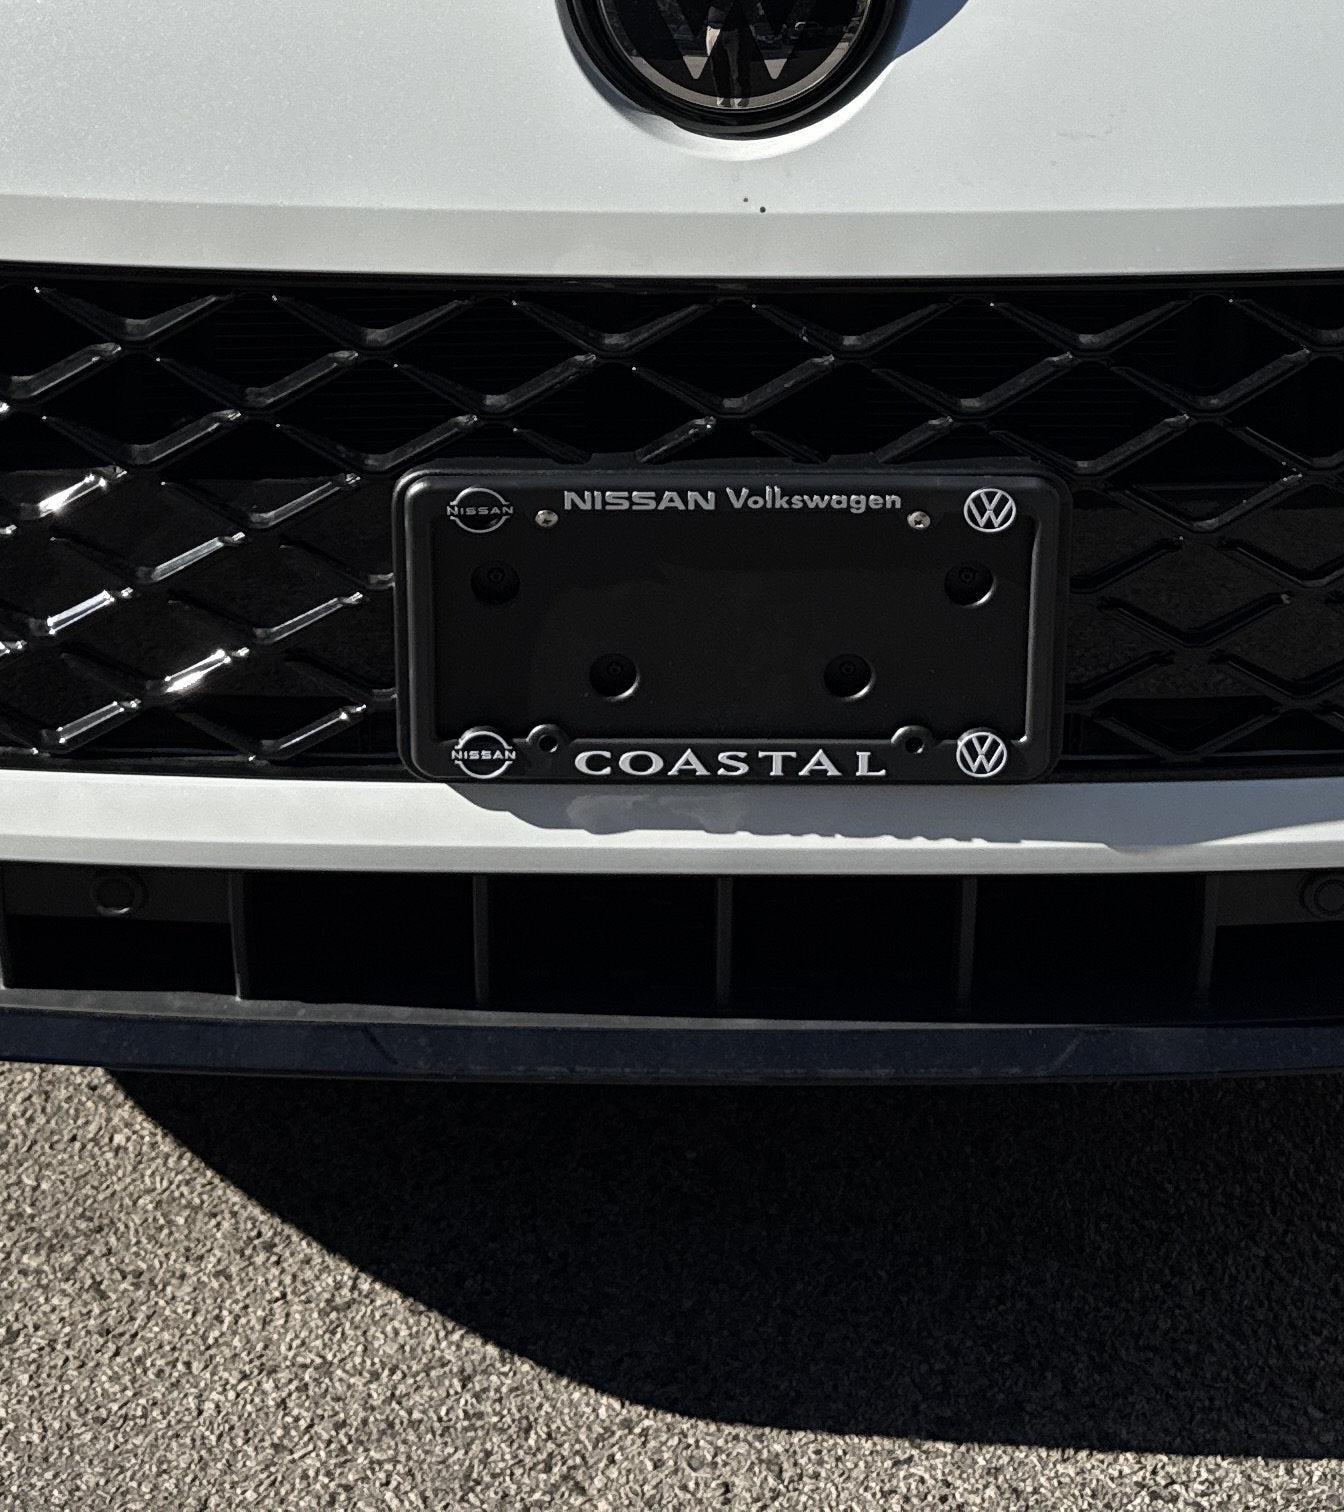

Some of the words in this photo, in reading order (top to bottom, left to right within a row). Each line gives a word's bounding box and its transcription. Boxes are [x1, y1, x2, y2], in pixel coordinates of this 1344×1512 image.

[563, 490, 716, 511] NISSAN
[726, 486, 902, 514] Volkswagen
[446, 505, 514, 516] NISSAN
[451, 749, 517, 760] NISSAN
[574, 747, 887, 777] COASTAL
